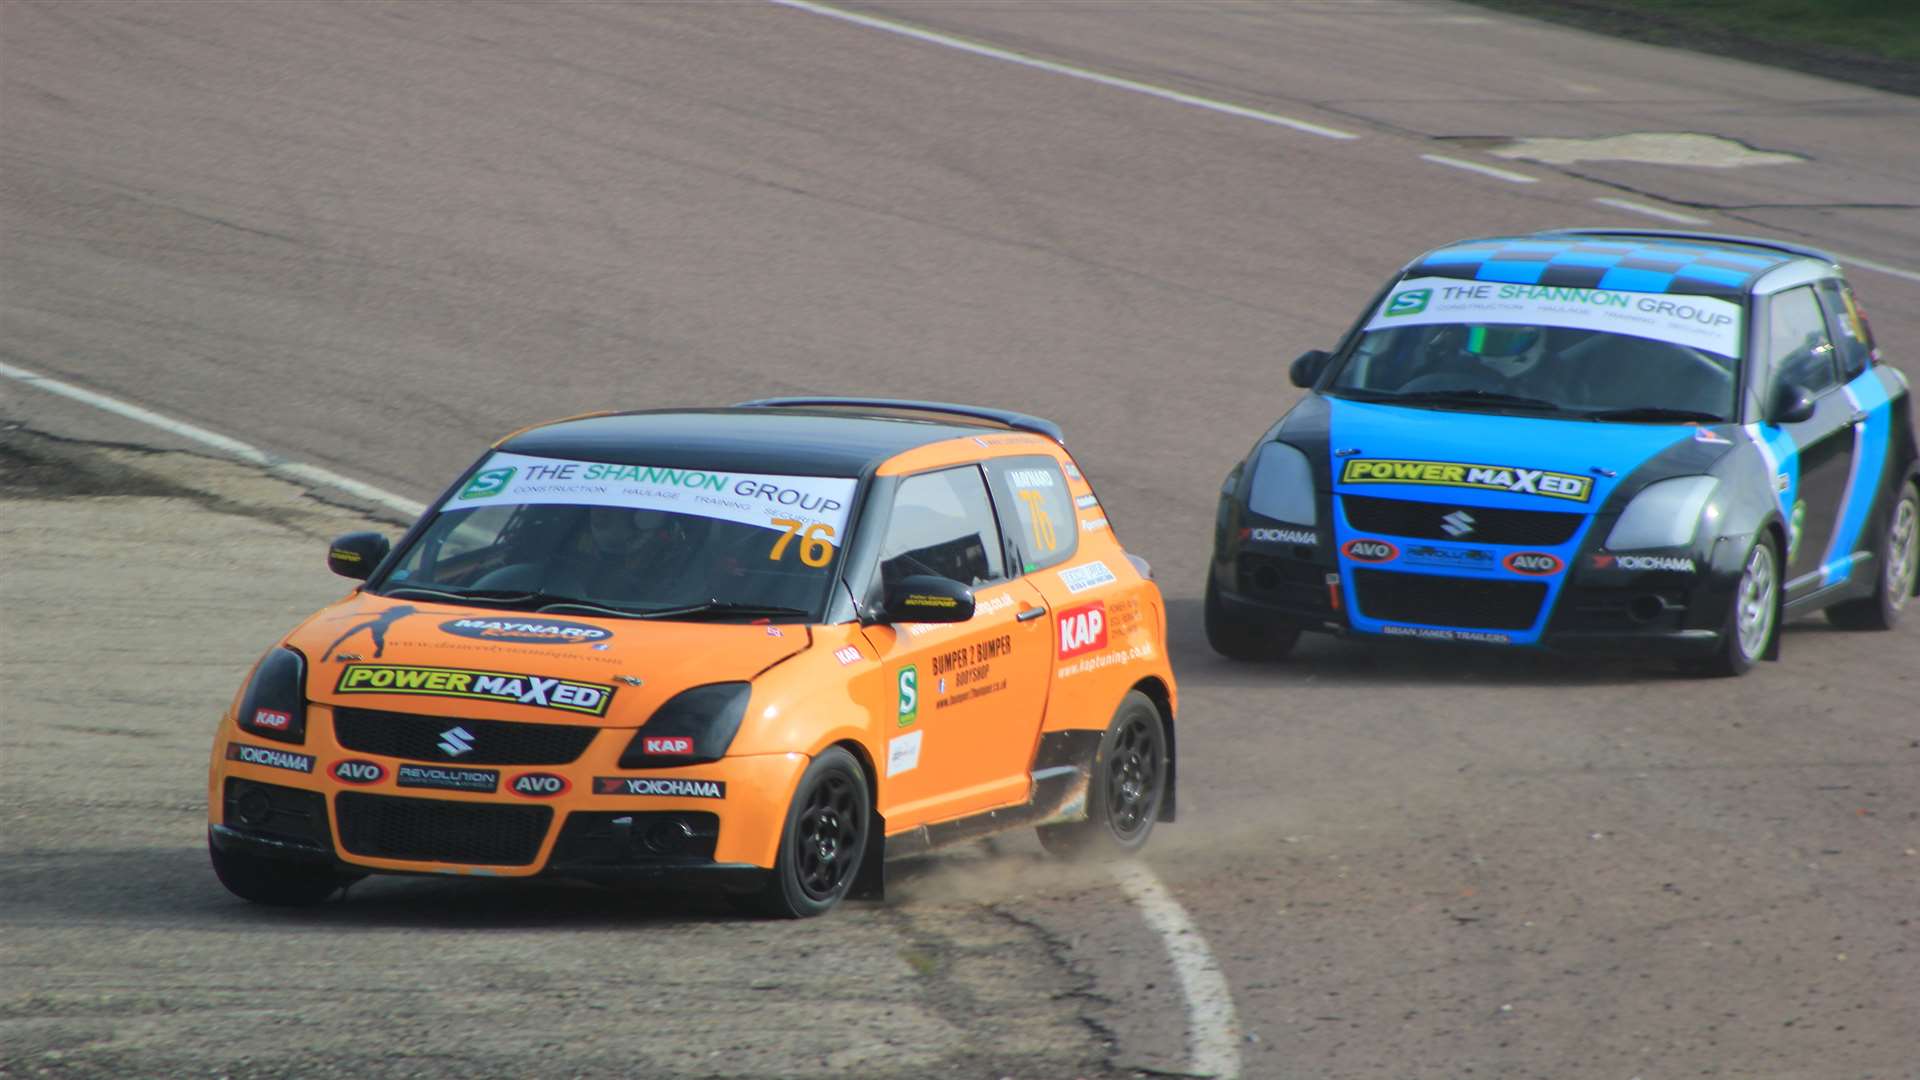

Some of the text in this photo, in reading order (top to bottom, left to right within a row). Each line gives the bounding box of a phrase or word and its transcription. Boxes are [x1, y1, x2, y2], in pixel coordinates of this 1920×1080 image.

[1442, 285, 1732, 326] THE SHANNON GROUP
[1350, 463, 1583, 494] POWER MAXED
[513, 485, 609, 496] CONSTRUCTION
[621, 487, 682, 500] HAULAGE
[694, 495, 753, 511] TRAINING
[523, 463, 842, 515] THE SHANNON GROUP
[769, 517, 836, 568] 76
[1251, 528, 1319, 545] YOKOHAMA
[1350, 543, 1390, 557] AVO
[1512, 555, 1554, 570] AVO
[1615, 555, 1696, 573] YOKOHAMA
[454, 618, 605, 638] MAYNARD
[1061, 609, 1102, 652] KAP
[932, 635, 1012, 676] BUMPER 2 BUMPER
[348, 669, 601, 707] POWER MAXED
[255, 711, 286, 727] KAP
[647, 740, 689, 753] KAP
[239, 746, 310, 771] YOKOHAMA
[336, 763, 380, 780] AVO
[399, 767, 496, 782] REVOLUTION
[515, 776, 561, 792] AVO
[626, 779, 721, 798] YOKOHAMA
